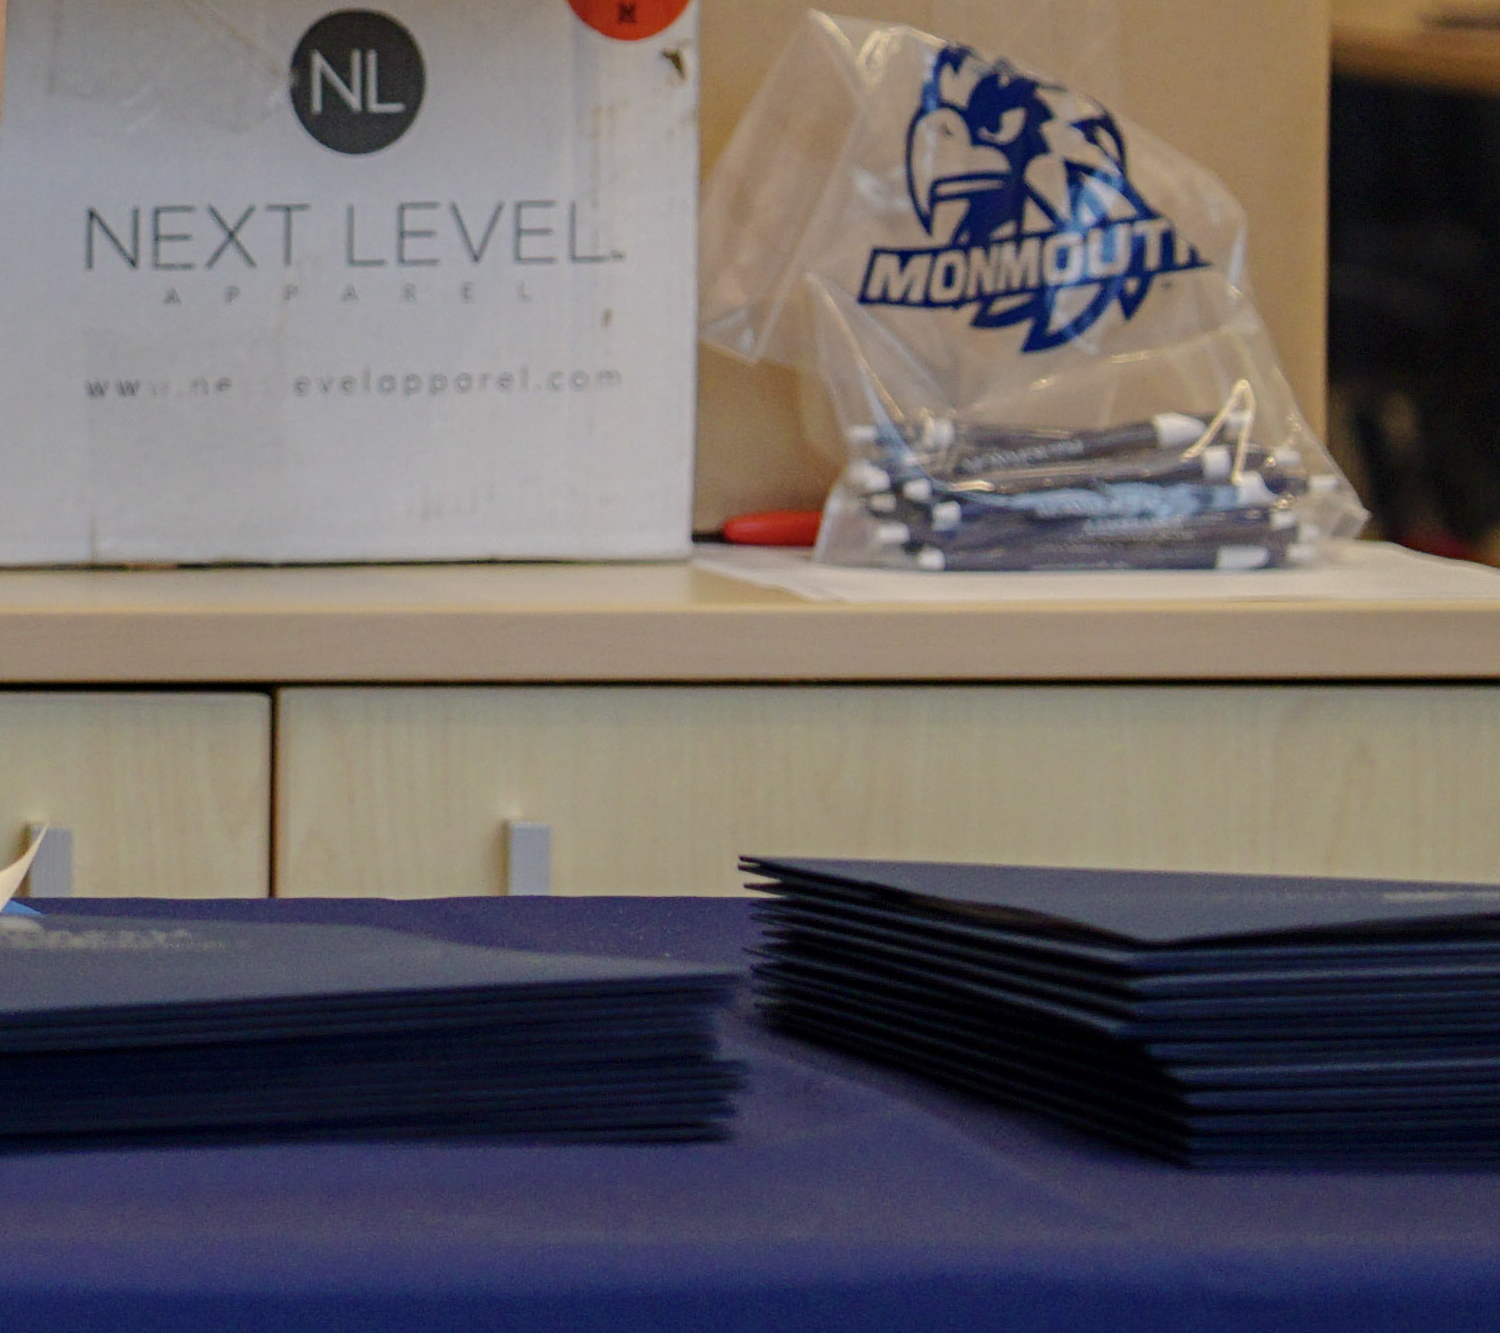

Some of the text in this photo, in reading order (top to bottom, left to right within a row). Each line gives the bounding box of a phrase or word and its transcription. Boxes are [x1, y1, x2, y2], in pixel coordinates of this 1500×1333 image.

[309, 49, 405, 114] NL
[86, 200, 610, 270] NEXT LEVEL
[163, 282, 532, 306] APPAREL
